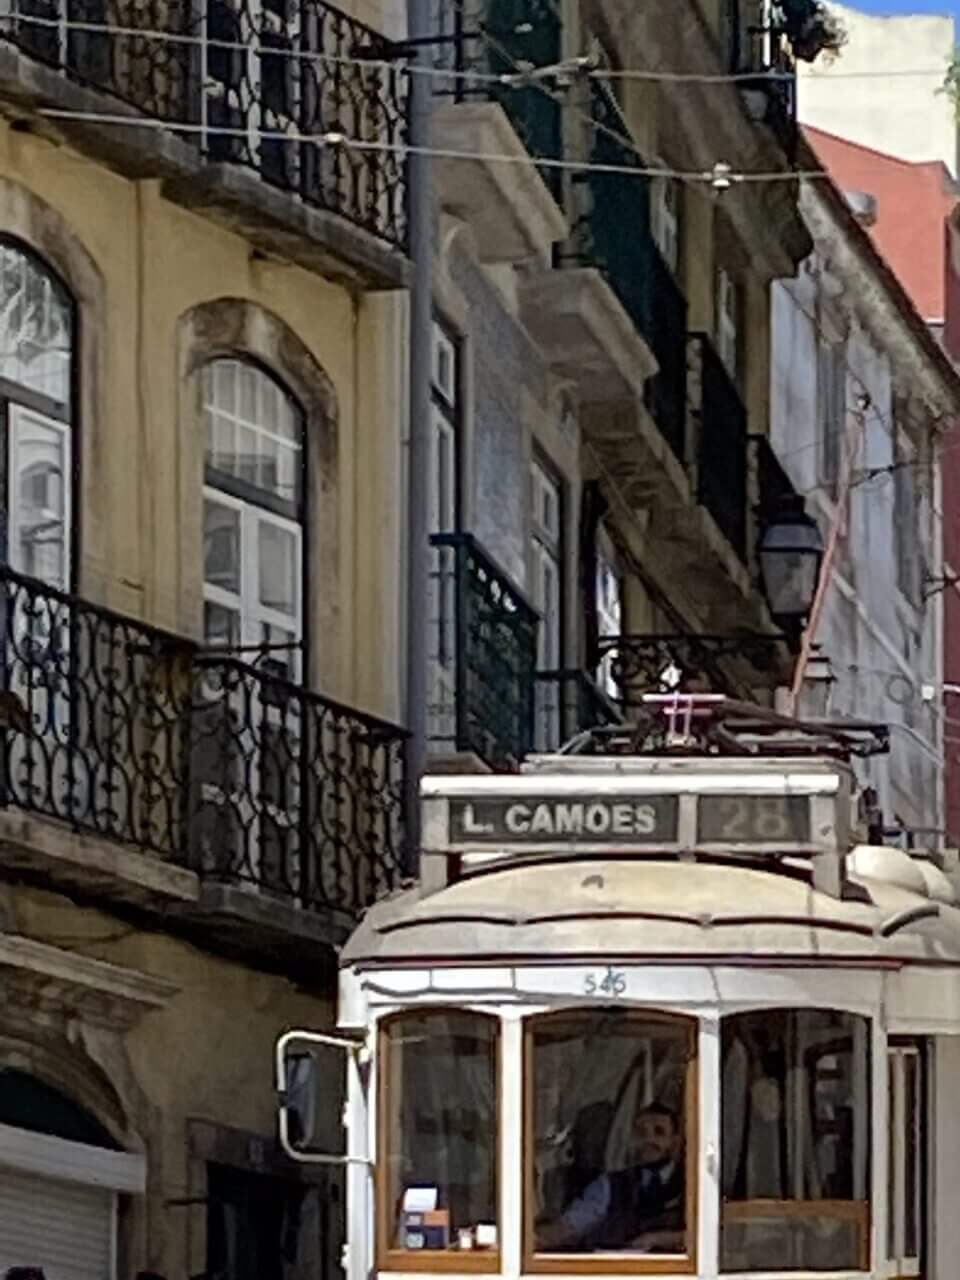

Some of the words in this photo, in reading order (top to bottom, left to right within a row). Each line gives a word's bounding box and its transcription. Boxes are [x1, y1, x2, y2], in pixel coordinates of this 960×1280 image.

[463, 804, 494, 833] L.
[505, 803, 656, 834] CAMOES
[719, 799, 789, 838] 28
[584, 973, 627, 994] 546
